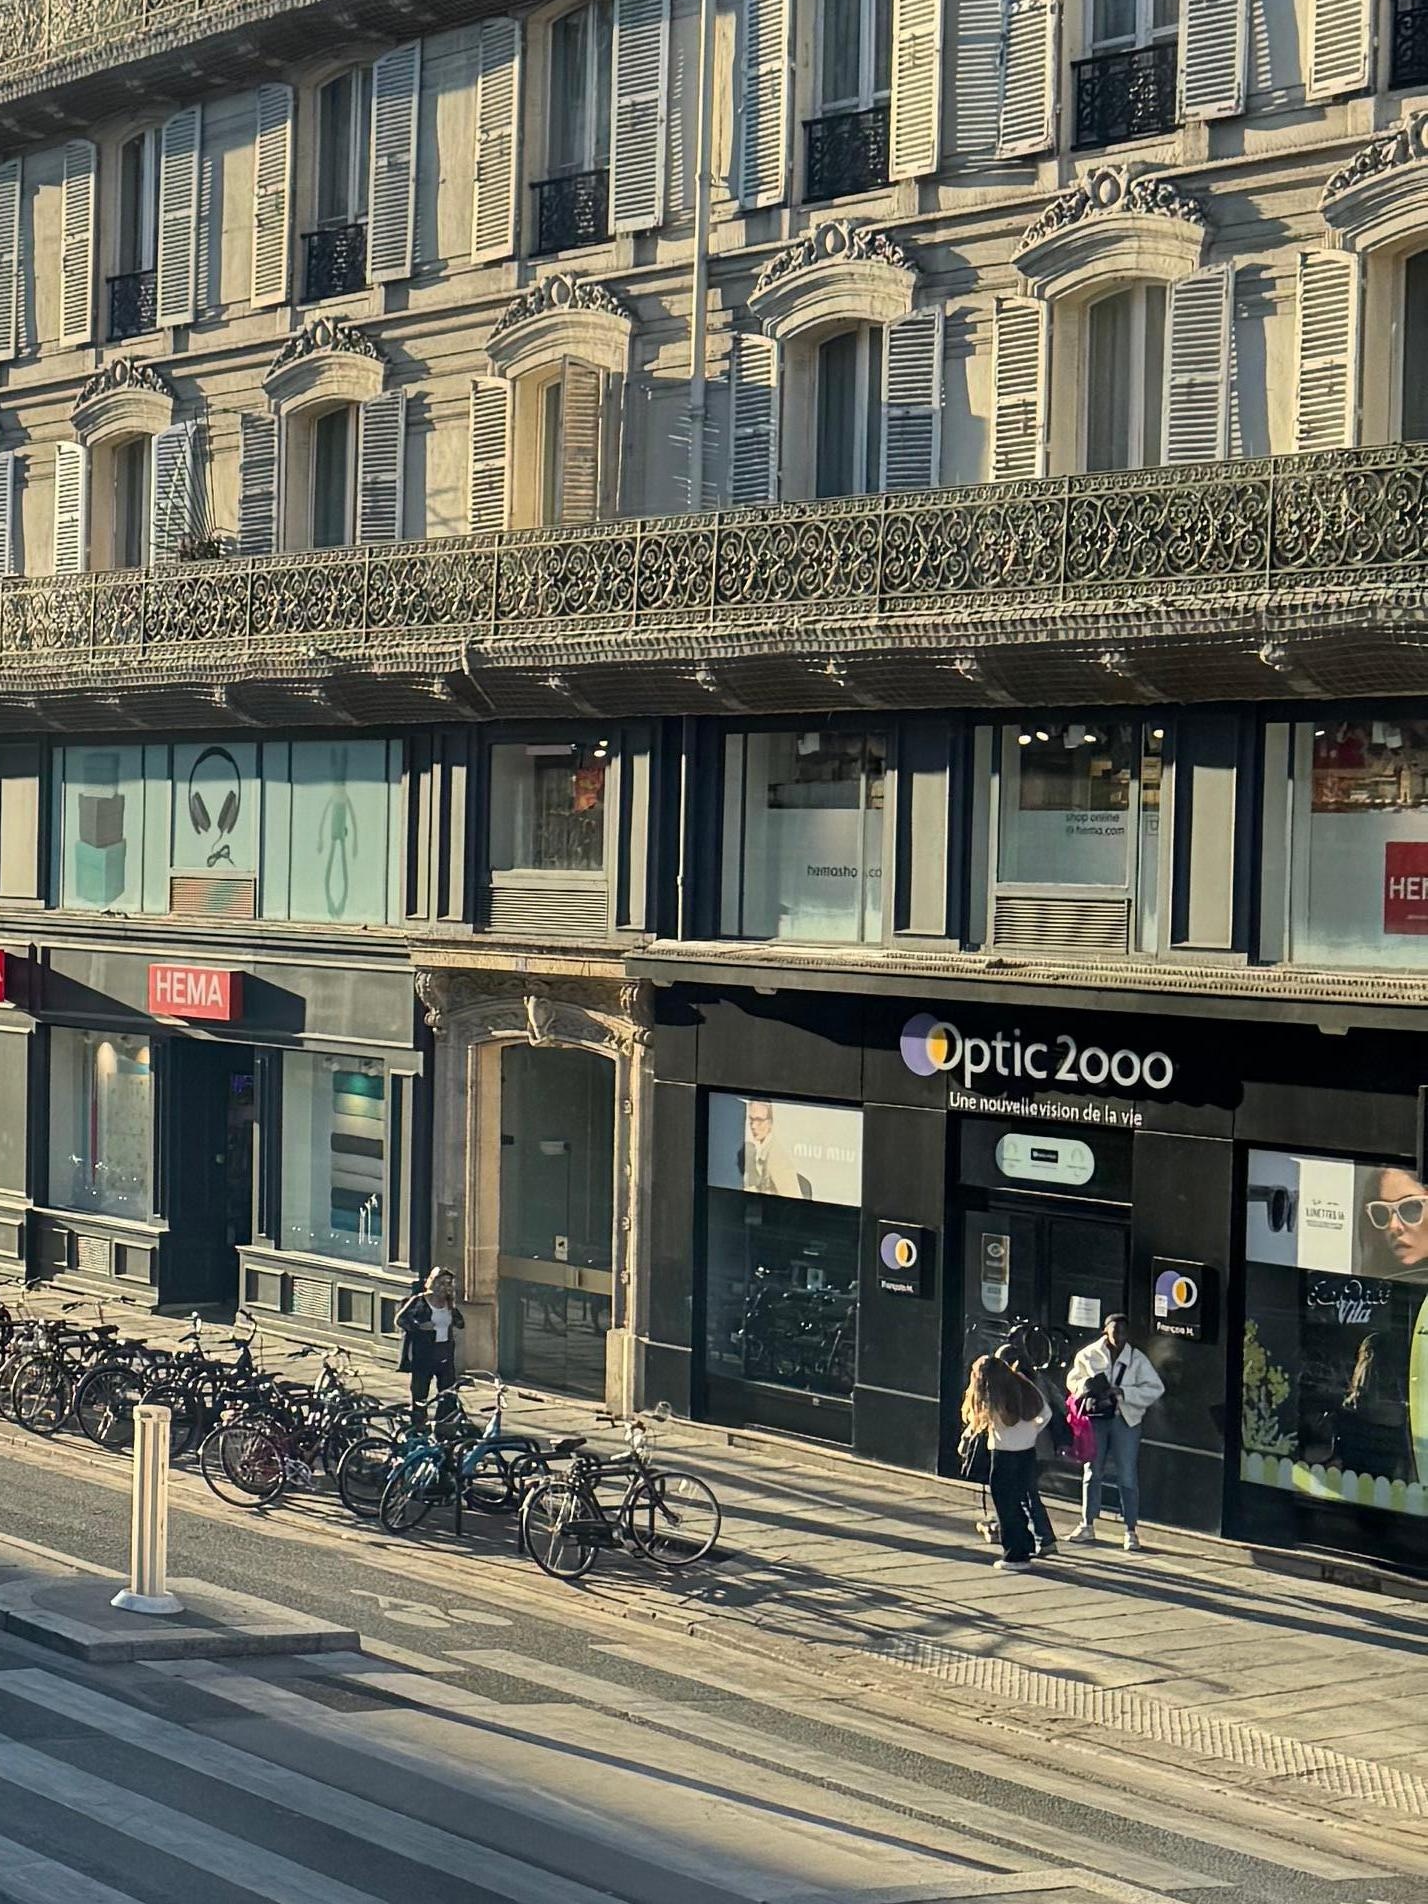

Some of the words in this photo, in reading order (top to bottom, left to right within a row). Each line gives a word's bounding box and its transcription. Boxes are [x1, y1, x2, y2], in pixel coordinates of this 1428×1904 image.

[156, 971, 223, 1008] HEMA
[925, 1022, 1048, 1089] Optic
[1054, 1035, 1174, 1089] 2000
[949, 1091, 977, 1110] Une
[980, 1095, 1038, 1116] nouvelle
[1039, 1101, 1079, 1120] vision
[1082, 1104, 1102, 1122] de
[1105, 1106, 1117, 1124] la
[1121, 1109, 1143, 1127] vie
